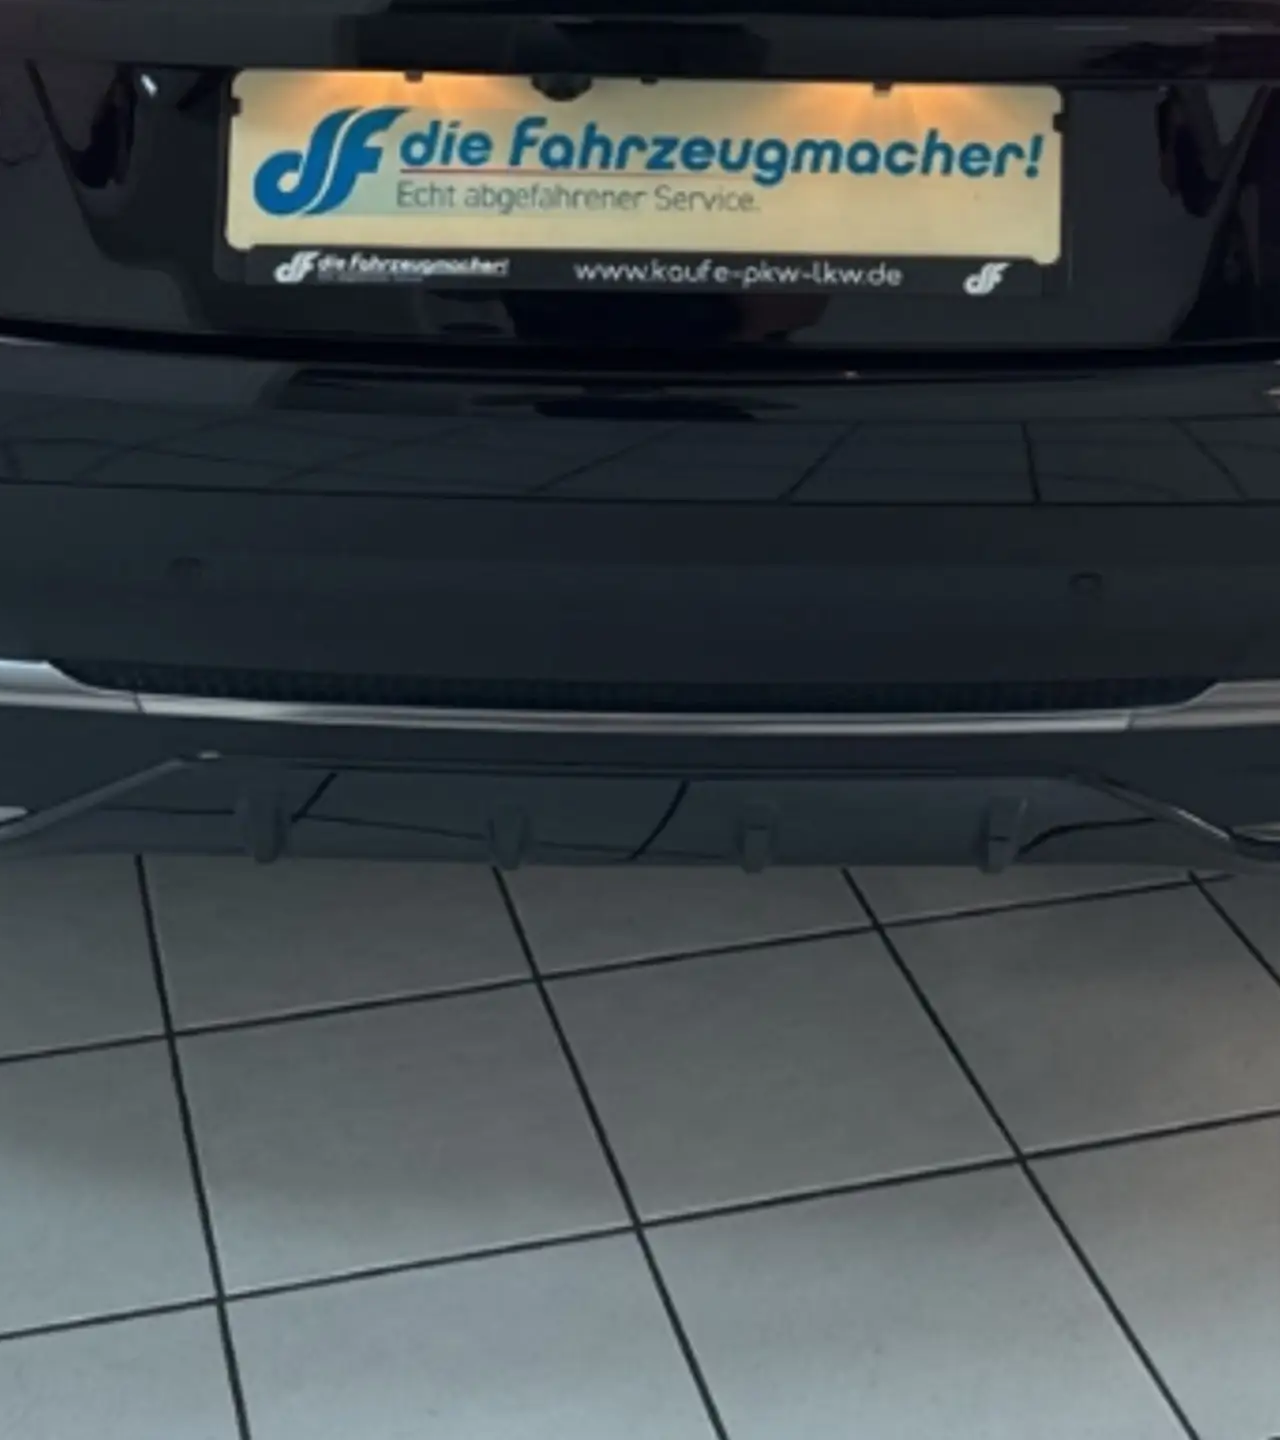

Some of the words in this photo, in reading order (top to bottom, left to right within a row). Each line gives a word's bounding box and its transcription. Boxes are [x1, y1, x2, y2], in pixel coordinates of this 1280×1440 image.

[399, 119, 493, 166] die
[509, 115, 1044, 187] Fahrzeugmacher!
[396, 180, 455, 208] Echt
[463, 181, 646, 215] abgefahrener
[654, 183, 761, 213] Service.
[574, 260, 904, 288] www.kaufe-pkw-lkw.de
